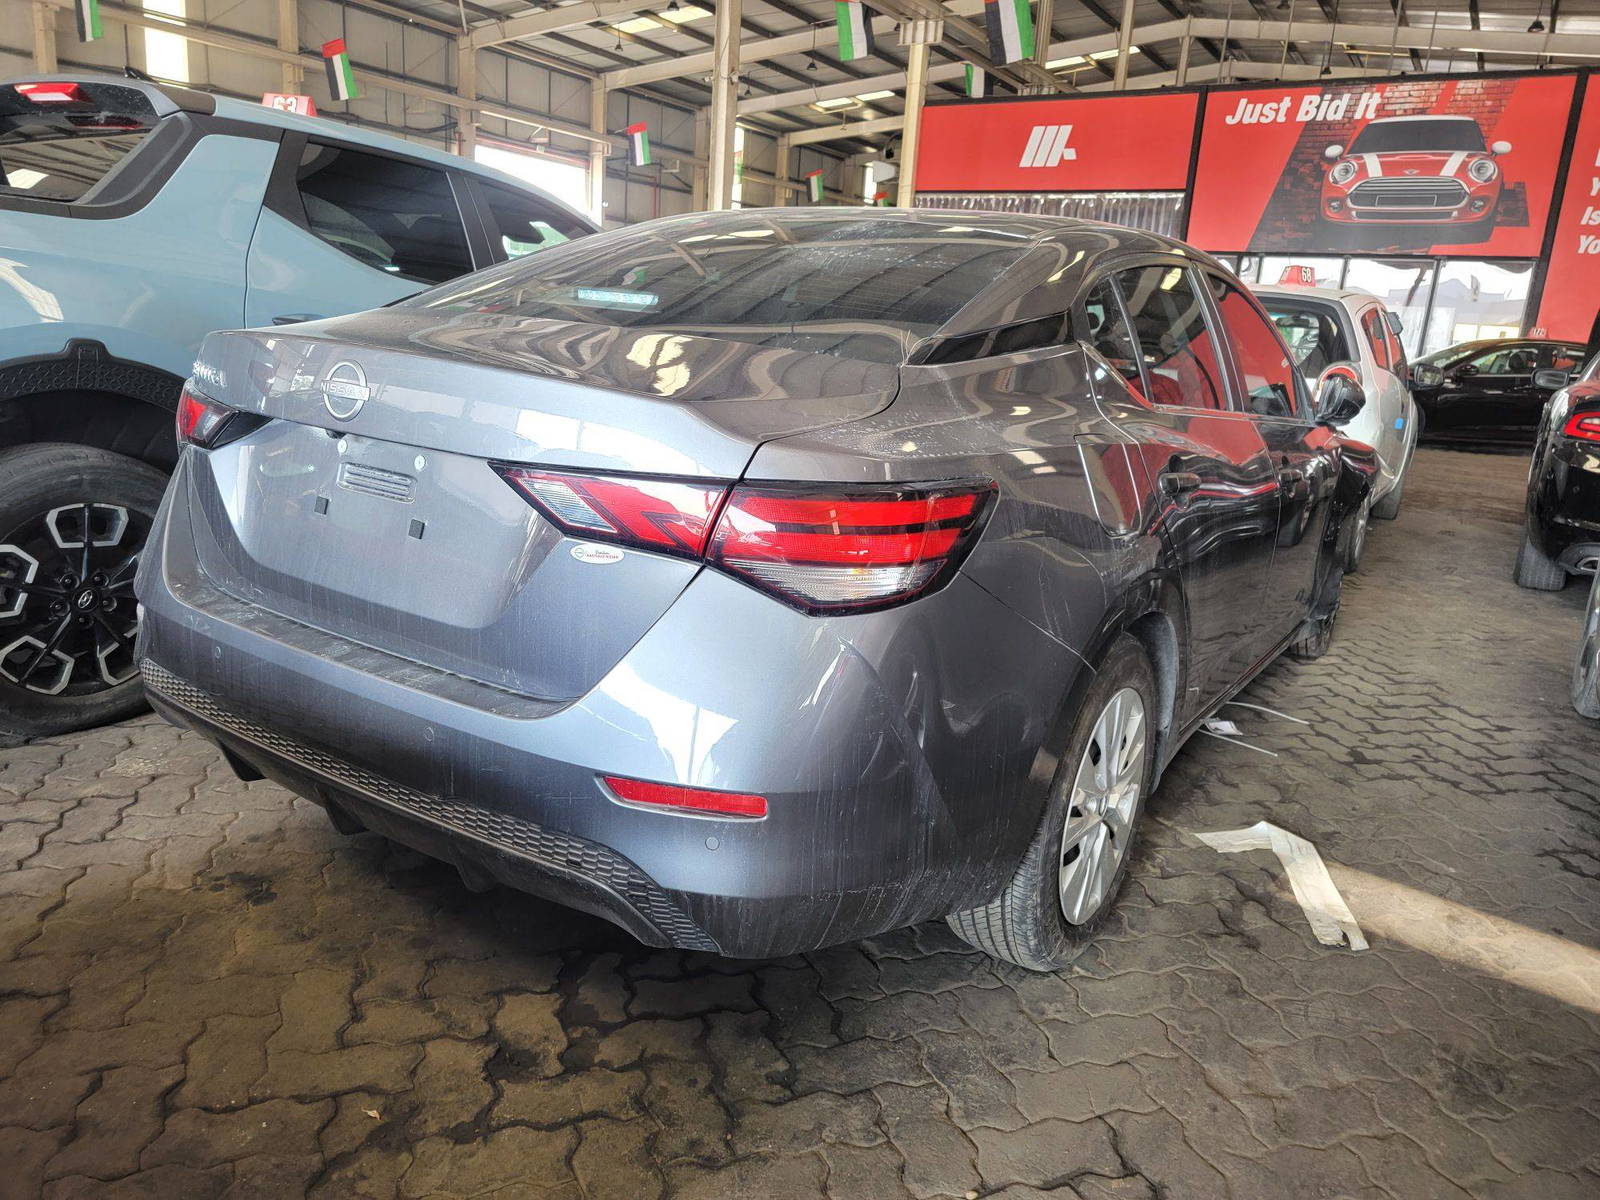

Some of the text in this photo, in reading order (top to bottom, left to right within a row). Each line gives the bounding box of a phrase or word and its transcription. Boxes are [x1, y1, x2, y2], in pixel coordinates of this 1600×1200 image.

[1225, 92, 1382, 125] Just Bid It
[1301, 267, 1312, 283] 68
[321, 381, 369, 400] NISSAN
